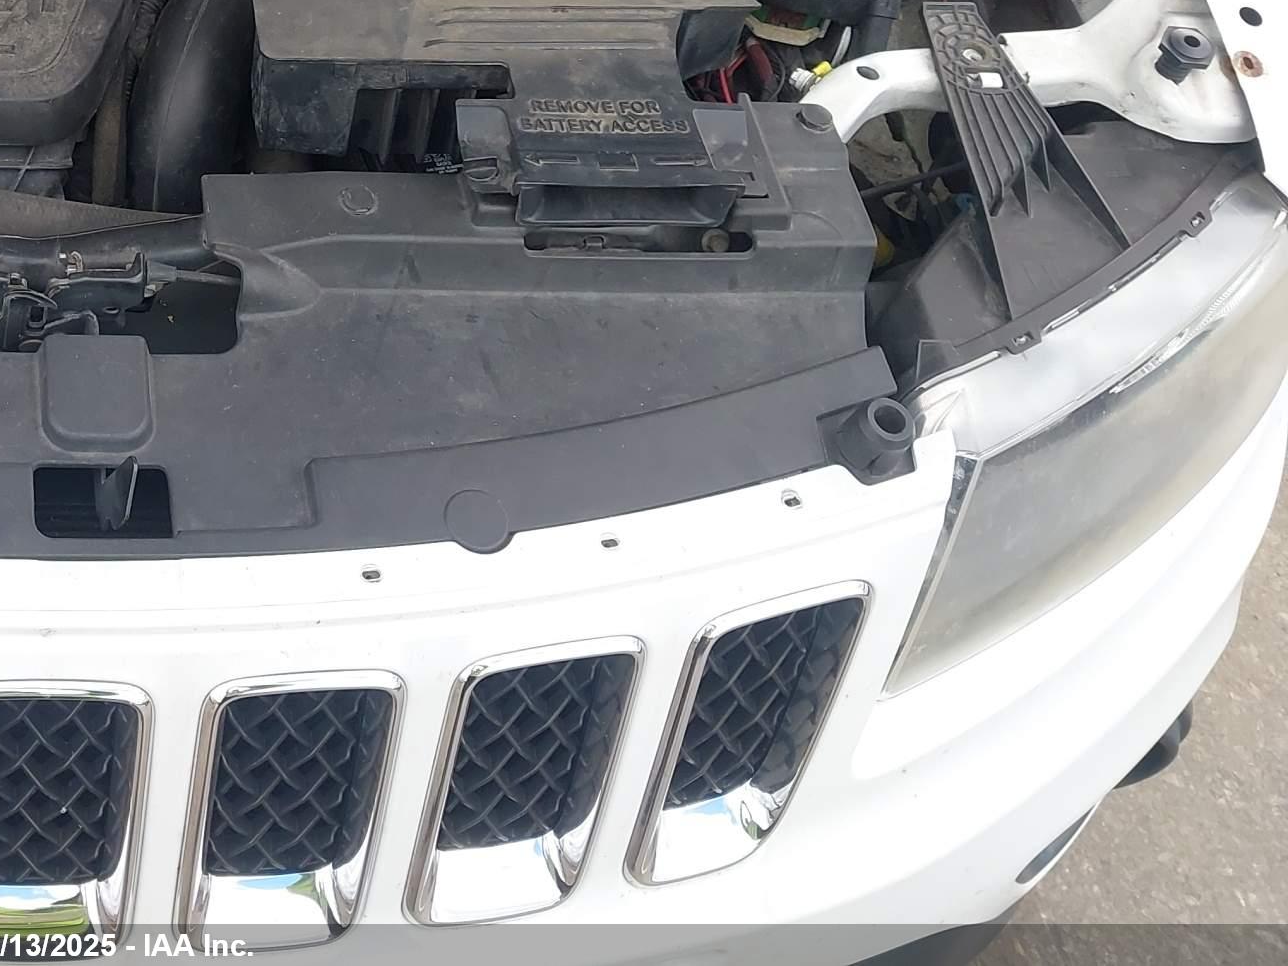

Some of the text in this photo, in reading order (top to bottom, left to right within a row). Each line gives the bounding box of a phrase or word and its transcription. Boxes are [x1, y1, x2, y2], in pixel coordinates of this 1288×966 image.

[529, 99, 661, 115] REMOVE FOR
[518, 117, 690, 134] BATTERY ACCESS
